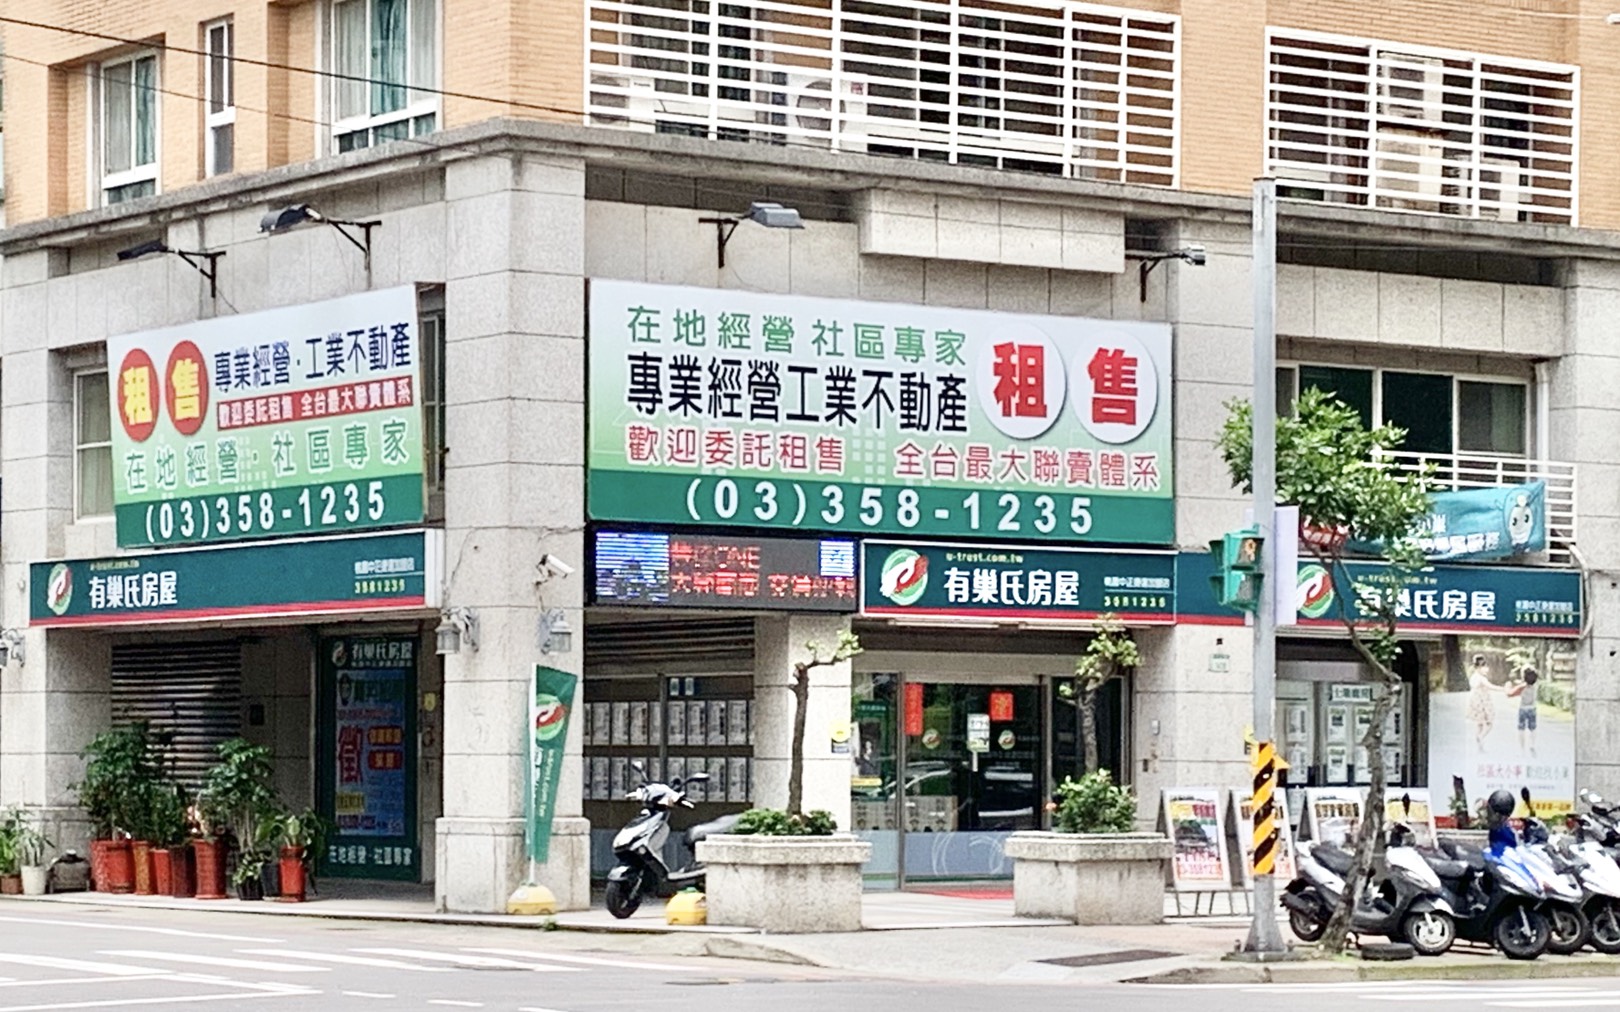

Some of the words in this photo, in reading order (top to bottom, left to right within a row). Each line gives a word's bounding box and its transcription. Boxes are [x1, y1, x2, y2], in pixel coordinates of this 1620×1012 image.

[627, 305, 796, 354] 在地經營
[811, 318, 967, 366] 社區專家
[121, 365, 153, 425] 租
[170, 357, 201, 421] 售
[627, 351, 968, 432] 專業經營工業不動產
[992, 341, 1048, 418] 租
[1086, 347, 1139, 426] 售
[628, 425, 843, 472] 歡迎委託租售
[896, 442, 1160, 488] 全台最大聯賣體系
[145, 480, 385, 543] (03)358-1235
[687, 478, 1093, 535] (03)358-1235
[88, 571, 178, 609] 有巢氏房屋
[943, 566, 1080, 606] 有巢氏房屋
